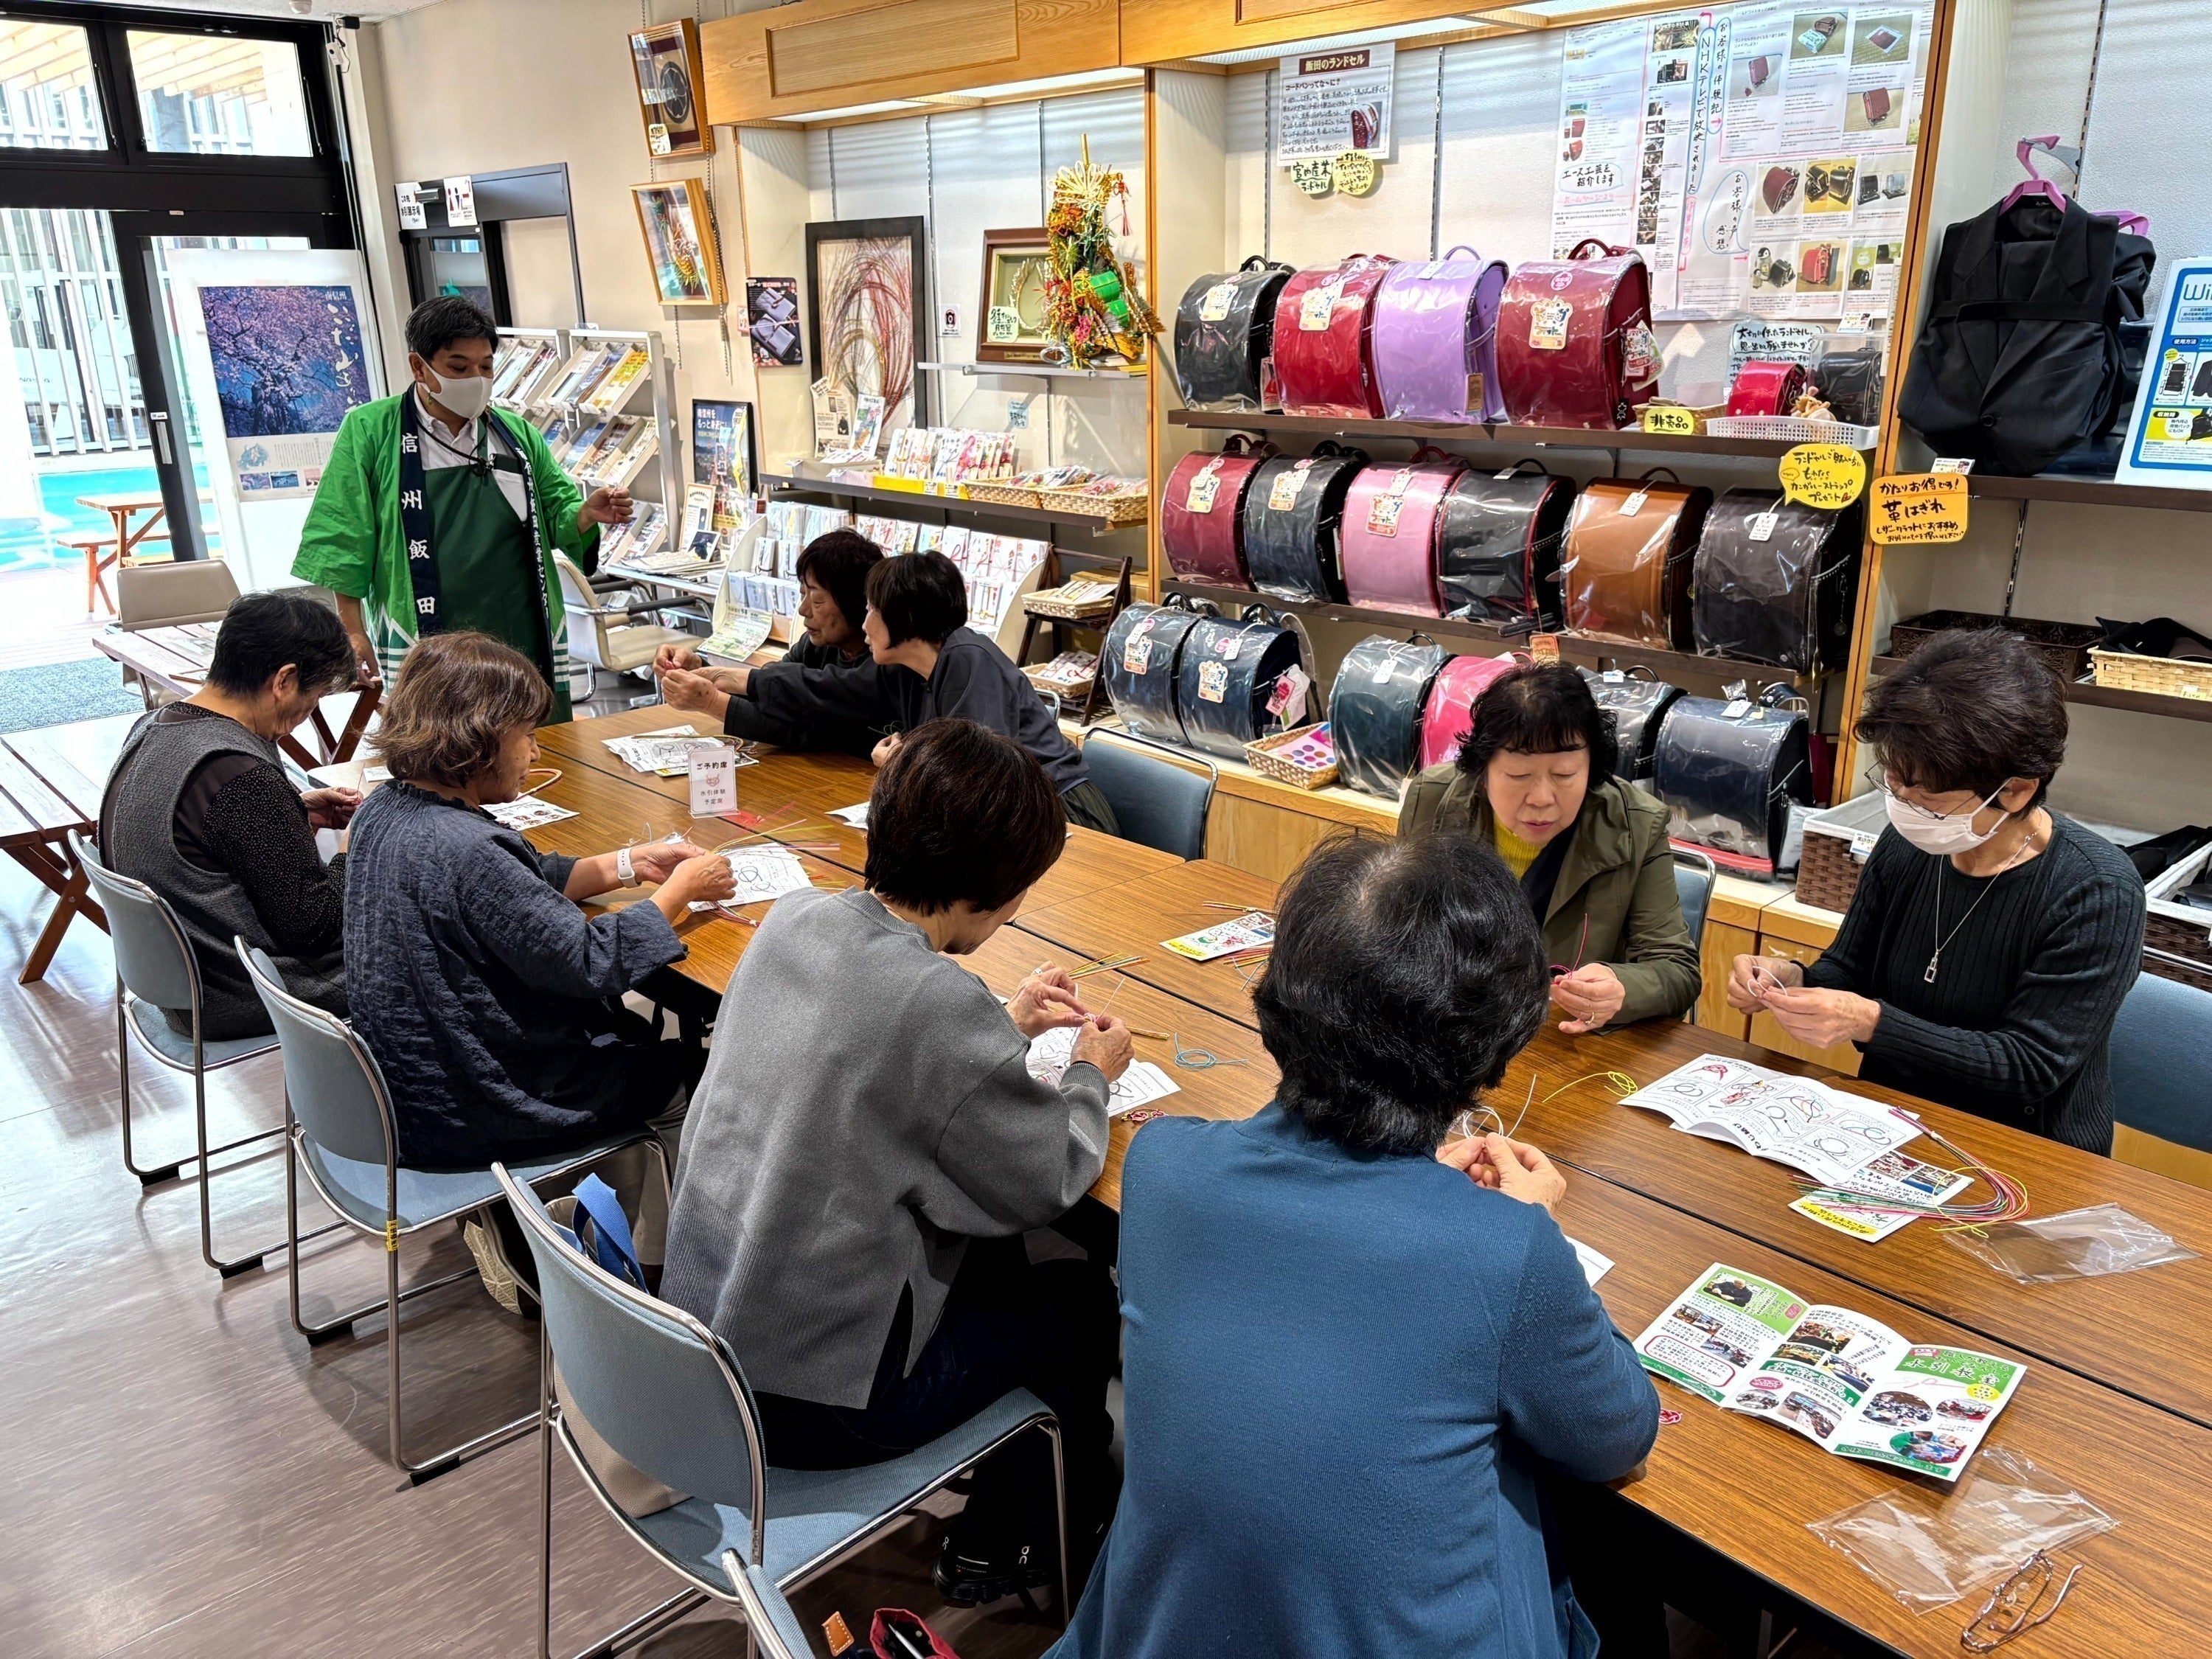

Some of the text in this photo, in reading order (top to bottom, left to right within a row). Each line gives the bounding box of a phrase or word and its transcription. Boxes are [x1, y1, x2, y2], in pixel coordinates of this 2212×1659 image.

[1305, 54, 1365, 72] 飯田のランドセル
[1711, 23, 1728, 114] お客様の体験記
[1688, 36, 1710, 192] NHKテレビで放映されました
[1562, 164, 1610, 178] エース工芸を
[1577, 173, 1614, 187] 紹介します
[1649, 413, 1688, 429] 非売品
[400, 432, 436, 615] 信州飯田
[1877, 521, 1958, 535] レザークラフトにおすすめ
[697, 762, 727, 770] ご予約席
[1905, 1358, 2000, 1387] 水引教室
